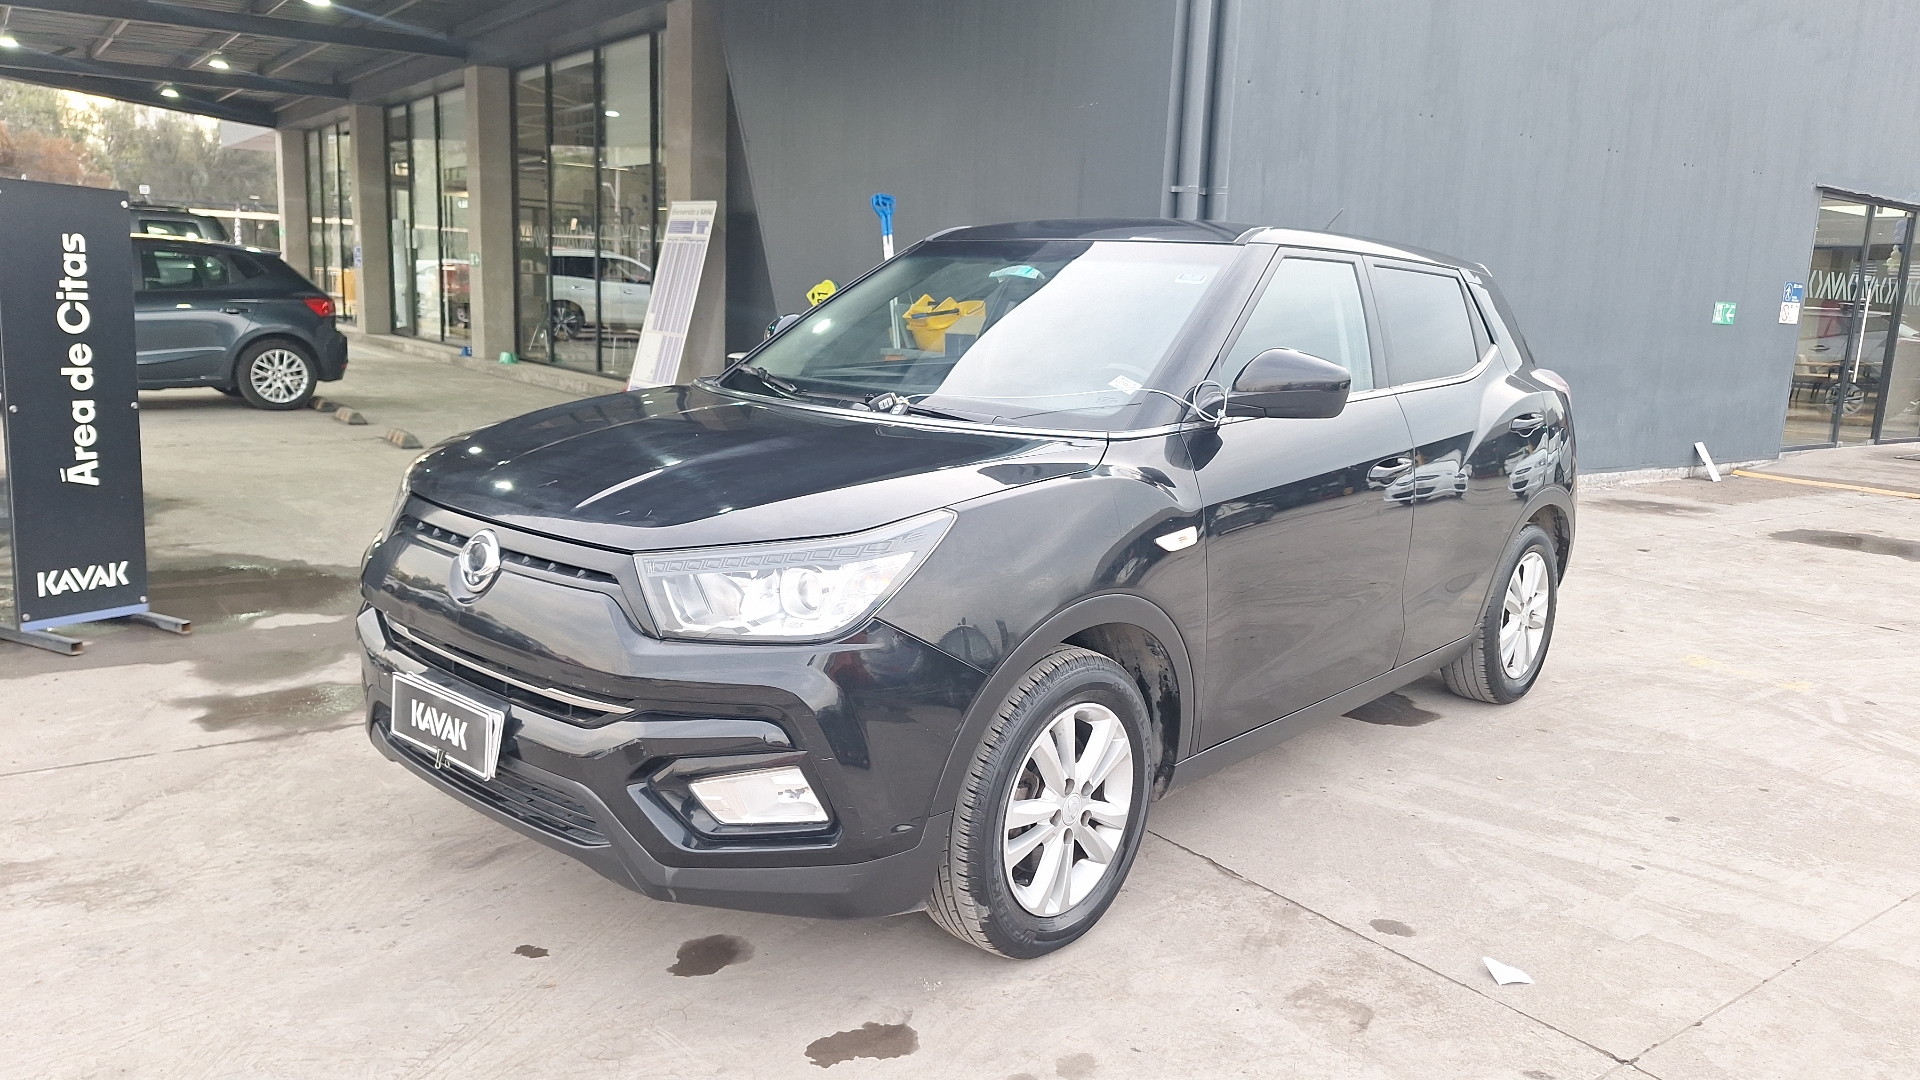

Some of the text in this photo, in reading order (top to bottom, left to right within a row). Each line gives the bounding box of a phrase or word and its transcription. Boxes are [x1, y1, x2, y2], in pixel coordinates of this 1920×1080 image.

[56, 233, 100, 486] Área de Citas
[37, 560, 129, 598] KAVAK
[411, 698, 468, 751] KAVAK
